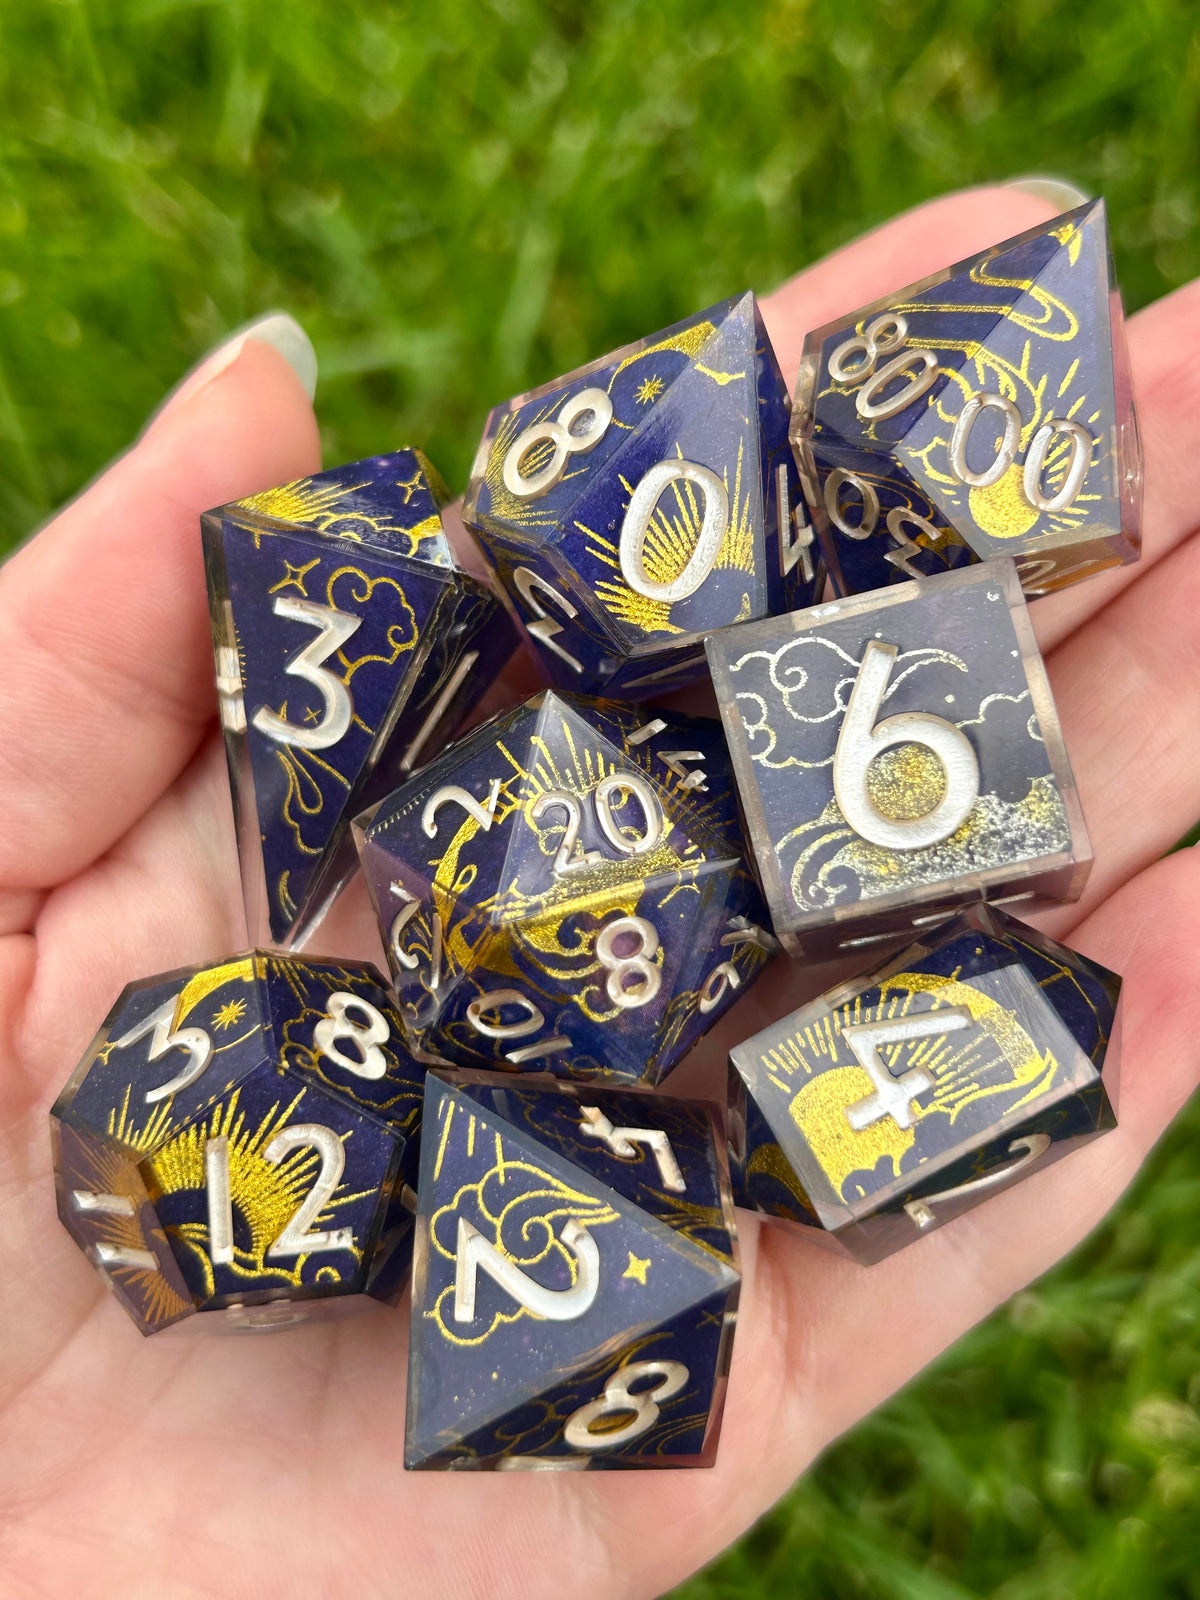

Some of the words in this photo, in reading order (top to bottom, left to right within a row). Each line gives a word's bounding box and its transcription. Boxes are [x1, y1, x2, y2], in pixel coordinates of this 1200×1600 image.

[828, 313, 939, 422] 80
[503, 387, 613, 497] 8
[950, 391, 1093, 512] 00
[619, 458, 729, 603] 0
[775, 463, 815, 584] 4
[252, 596, 362, 750] 3
[833, 640, 979, 850] 6
[421, 777, 502, 840] 2
[532, 771, 664, 879] 20
[595, 916, 662, 1009] 8
[116, 993, 214, 1103] 3
[313, 991, 390, 1080] 8
[842, 1006, 974, 1131] 4
[205, 1123, 353, 1265] 12
[454, 1216, 600, 1322] 2
[564, 1360, 690, 1448] 8
